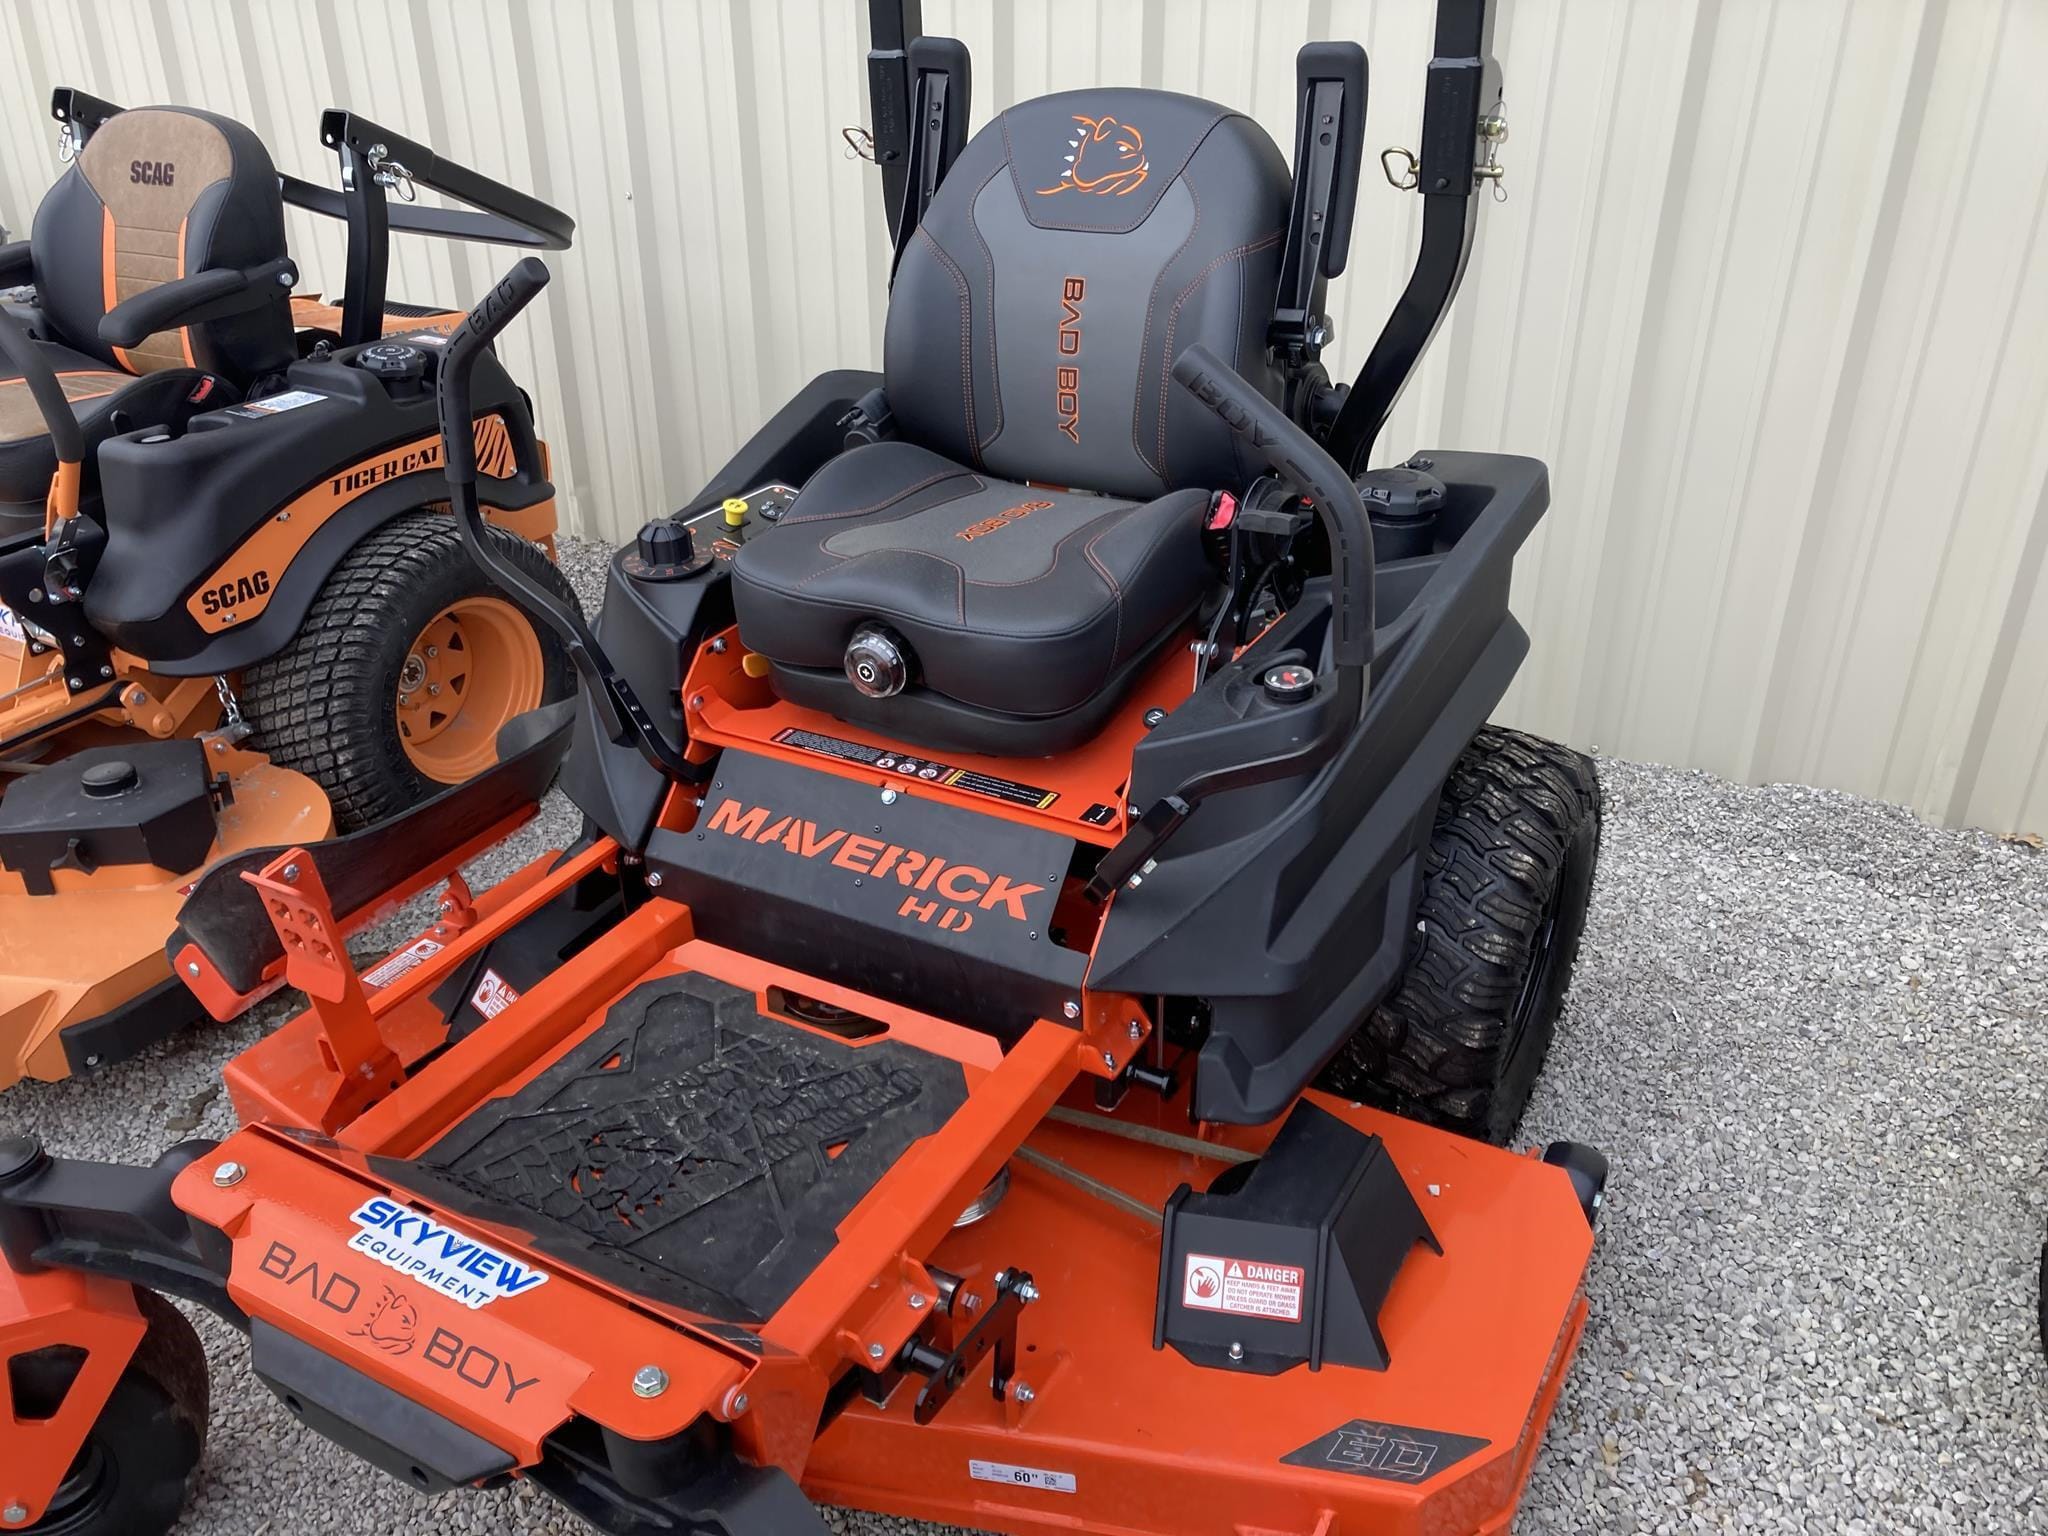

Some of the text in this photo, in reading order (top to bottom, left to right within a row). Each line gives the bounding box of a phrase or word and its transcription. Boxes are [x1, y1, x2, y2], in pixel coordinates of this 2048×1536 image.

[130, 160, 175, 187] SCAG
[1057, 276, 1086, 444] BAD BOY
[329, 444, 442, 497] TIGER CAT
[201, 570, 271, 616] SCAG
[706, 798, 1046, 921] MAVERICK
[898, 896, 974, 932] HD
[355, 1233, 491, 1304] EQUIPMENT
[357, 1201, 542, 1292] SKYVIEW
[1247, 1265, 1299, 1284] DANGER
[1249, 1290, 1273, 1299] OPERATE
[1274, 1293, 1296, 1302] MOWER
[259, 1240, 541, 1404] BAD BOY
[1229, 1303, 1254, 1311] CATCHER
[1014, 1471, 1038, 1483] 60"
